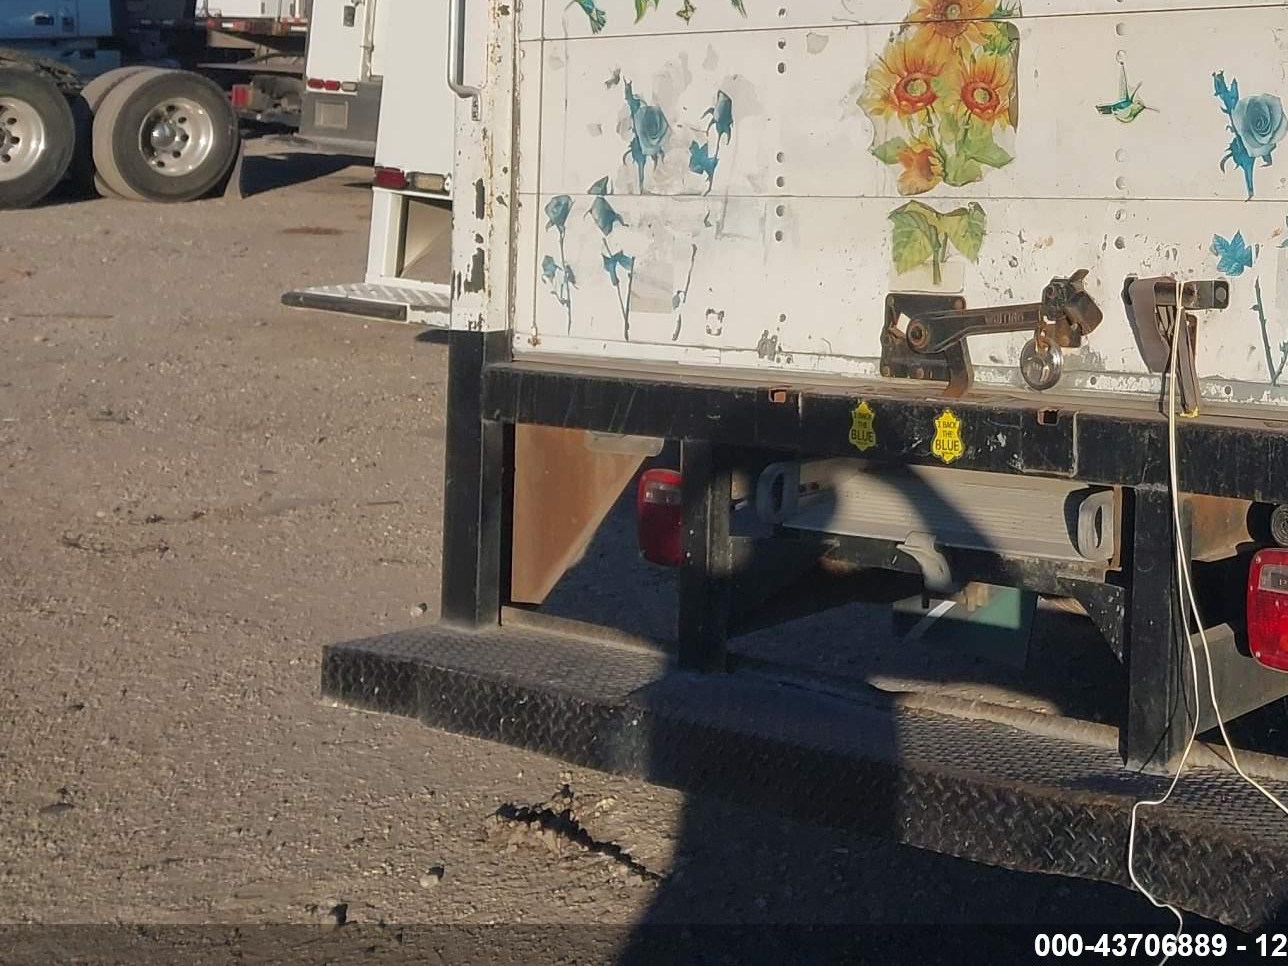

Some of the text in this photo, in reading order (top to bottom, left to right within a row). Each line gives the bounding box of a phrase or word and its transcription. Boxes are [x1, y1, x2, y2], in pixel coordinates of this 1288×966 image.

[942, 421, 957, 429] BACK
[851, 428, 873, 443] BLUE
[942, 430, 953, 438] THE
[935, 439, 959, 452] BLUE
